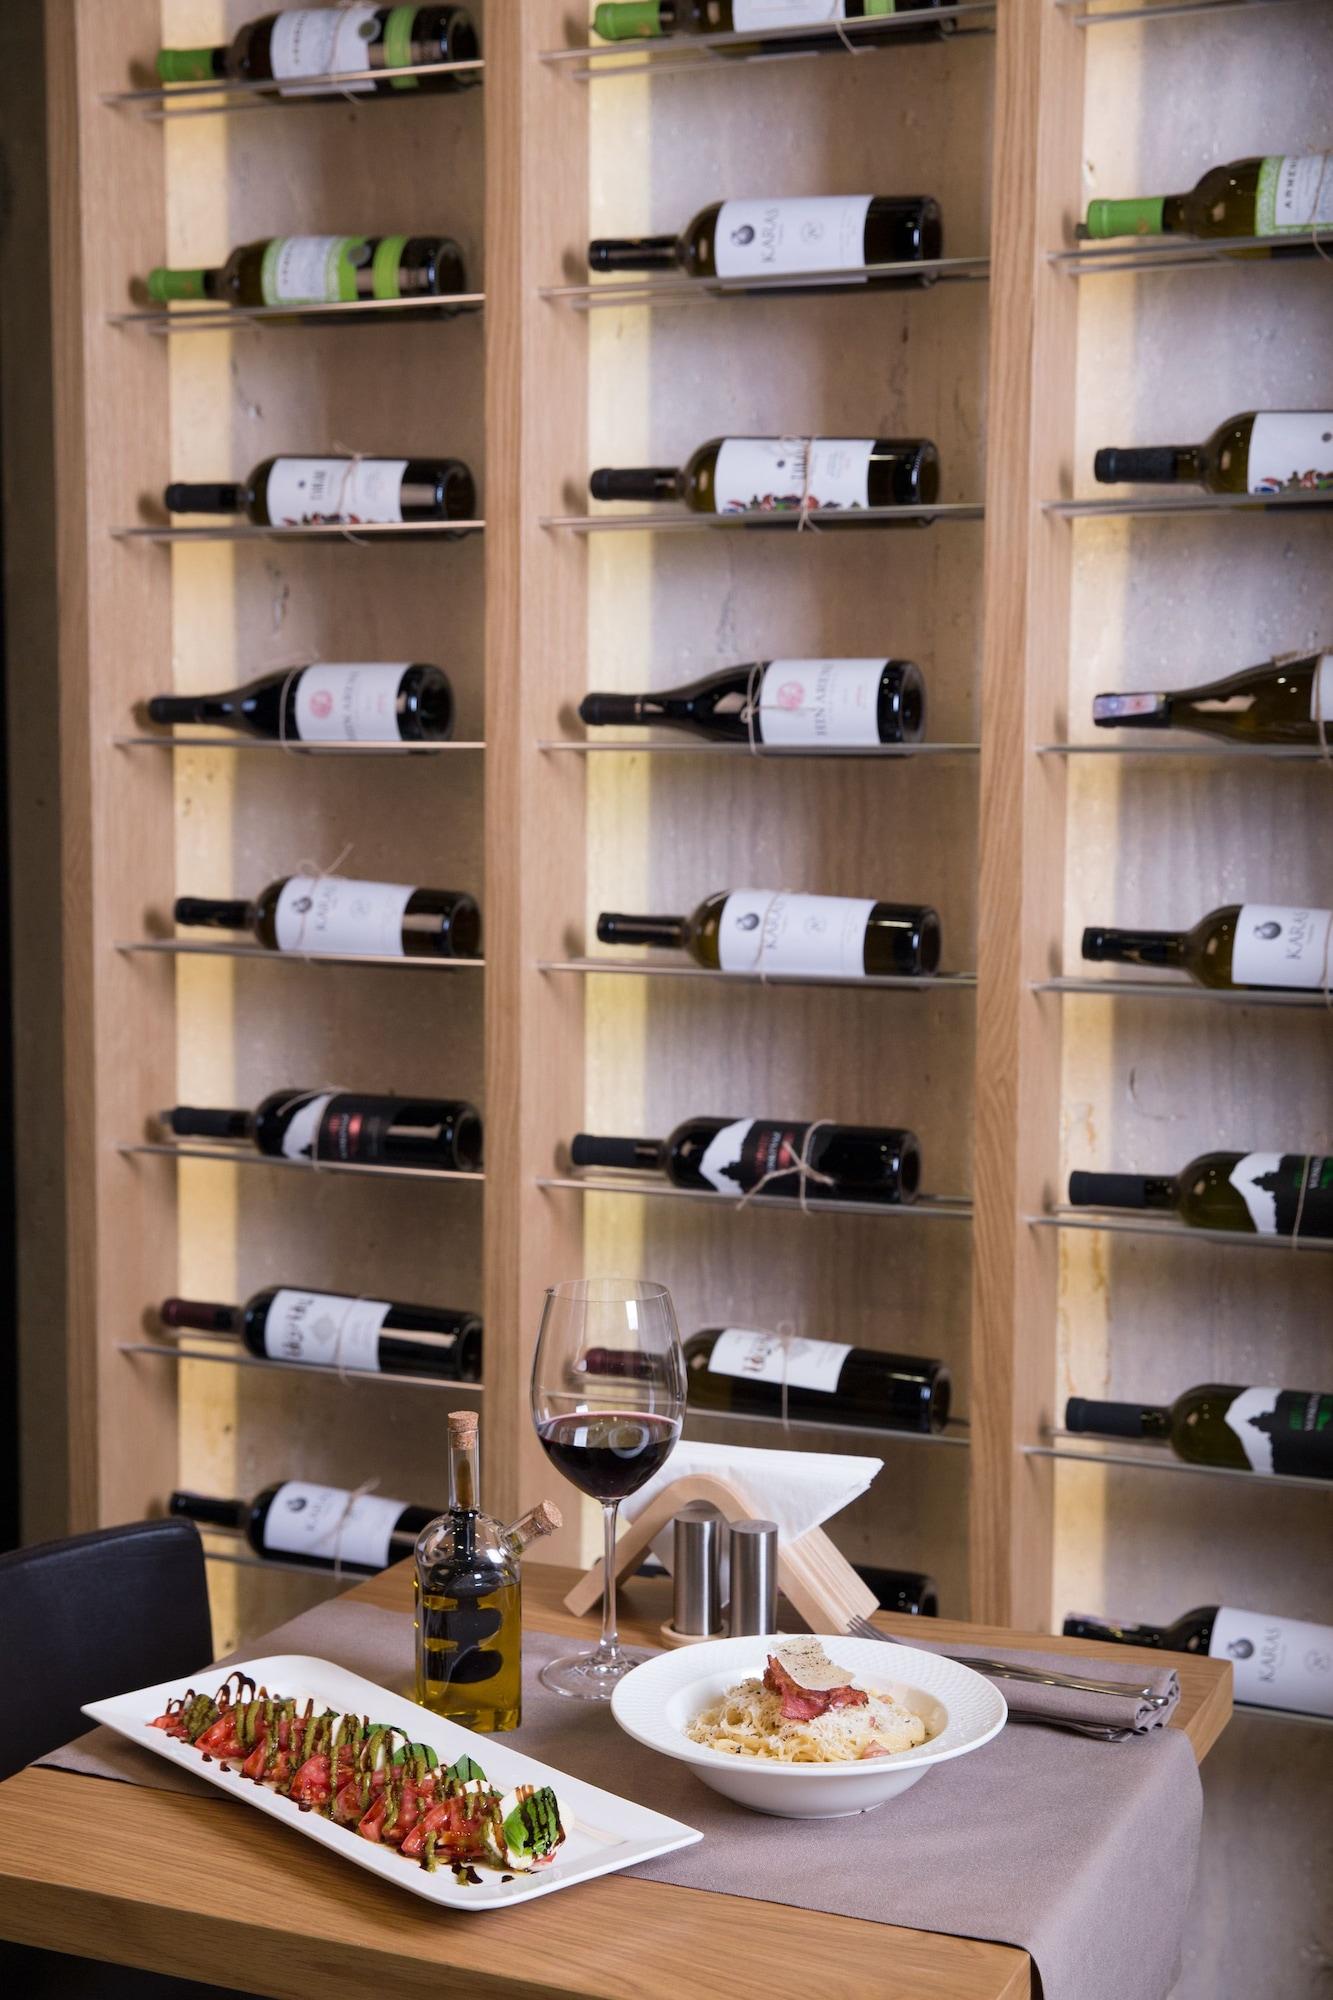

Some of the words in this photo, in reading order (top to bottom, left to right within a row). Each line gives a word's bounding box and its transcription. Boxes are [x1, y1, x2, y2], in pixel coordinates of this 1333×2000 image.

[760, 207, 781, 263] KARAS
[1285, 911, 1309, 961] KARAS
[1258, 1627, 1282, 1682] KARAS
